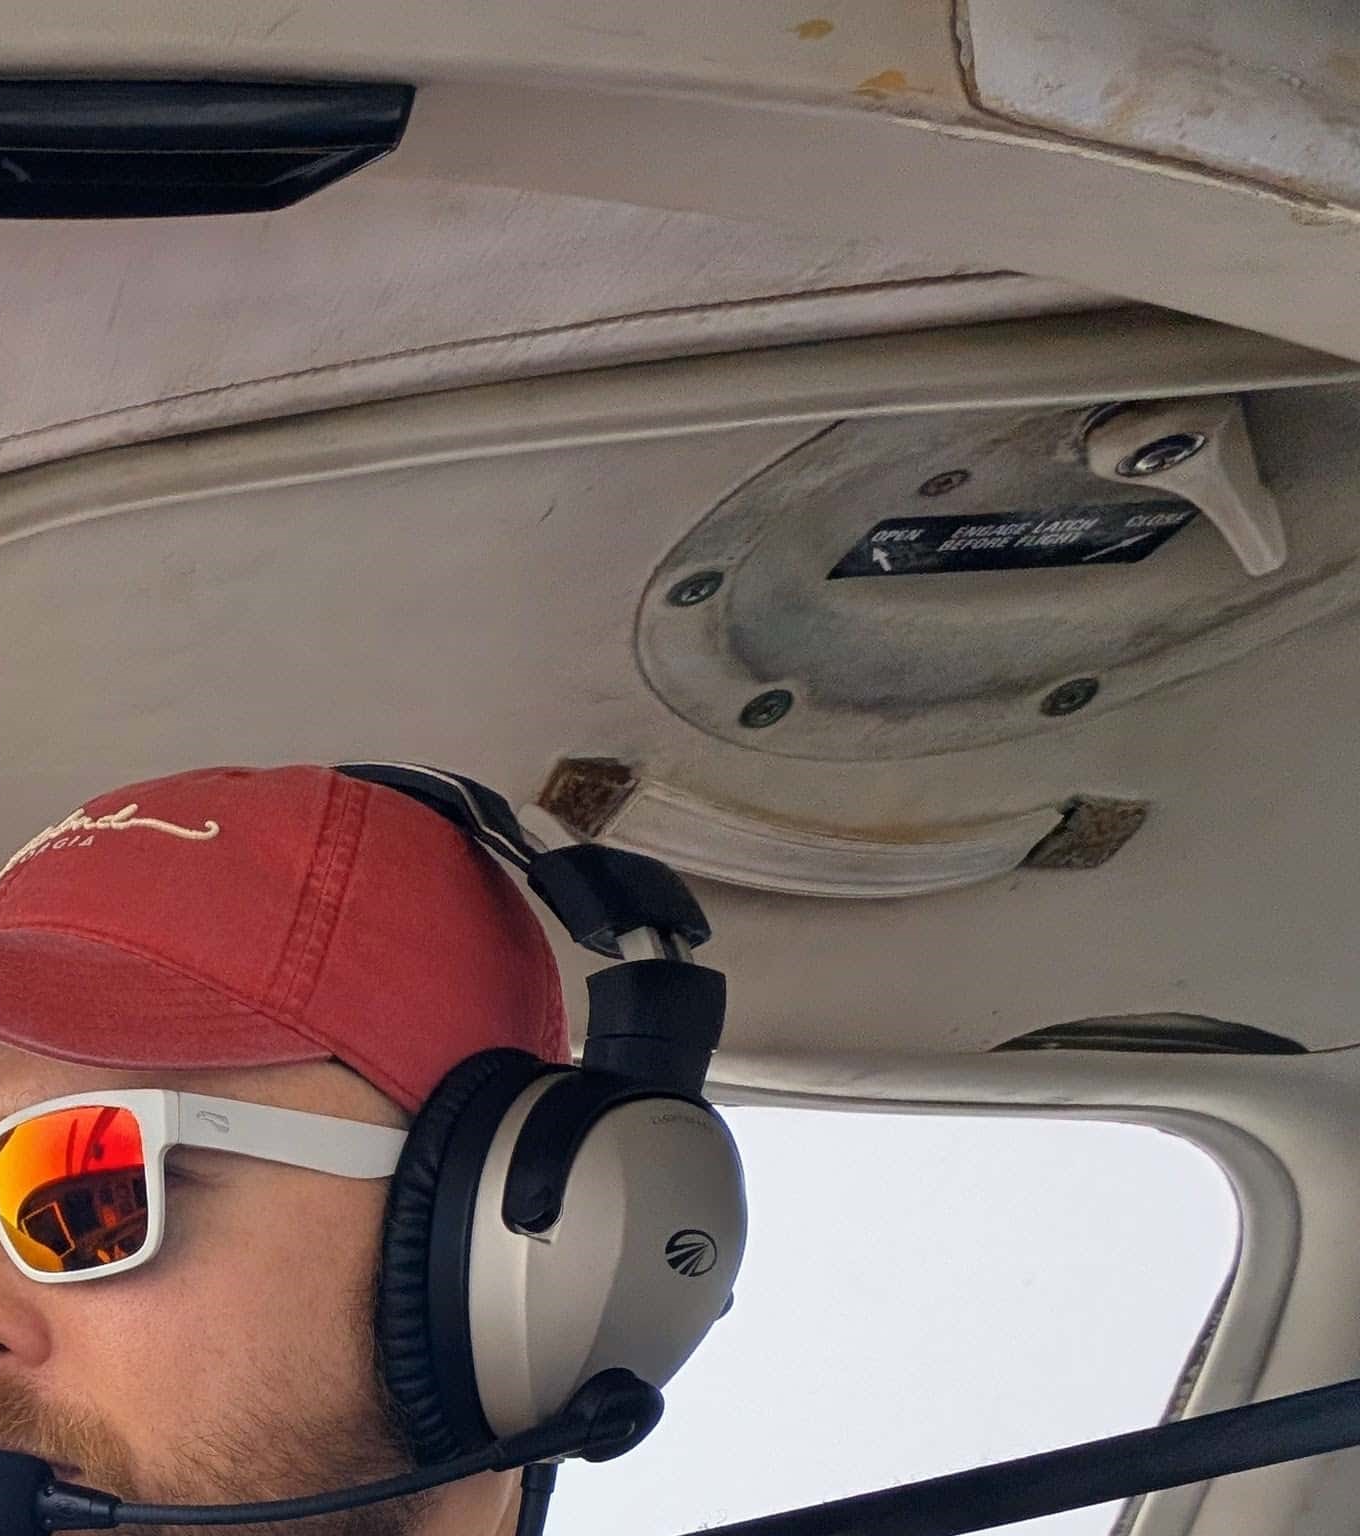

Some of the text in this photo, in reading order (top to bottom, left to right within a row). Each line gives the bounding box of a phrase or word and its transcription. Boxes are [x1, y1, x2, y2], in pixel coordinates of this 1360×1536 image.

[871, 528, 925, 543] OPEN
[951, 517, 1101, 538] ENGAGE LATCH
[935, 531, 1082, 552] BEFORE FLIGHT
